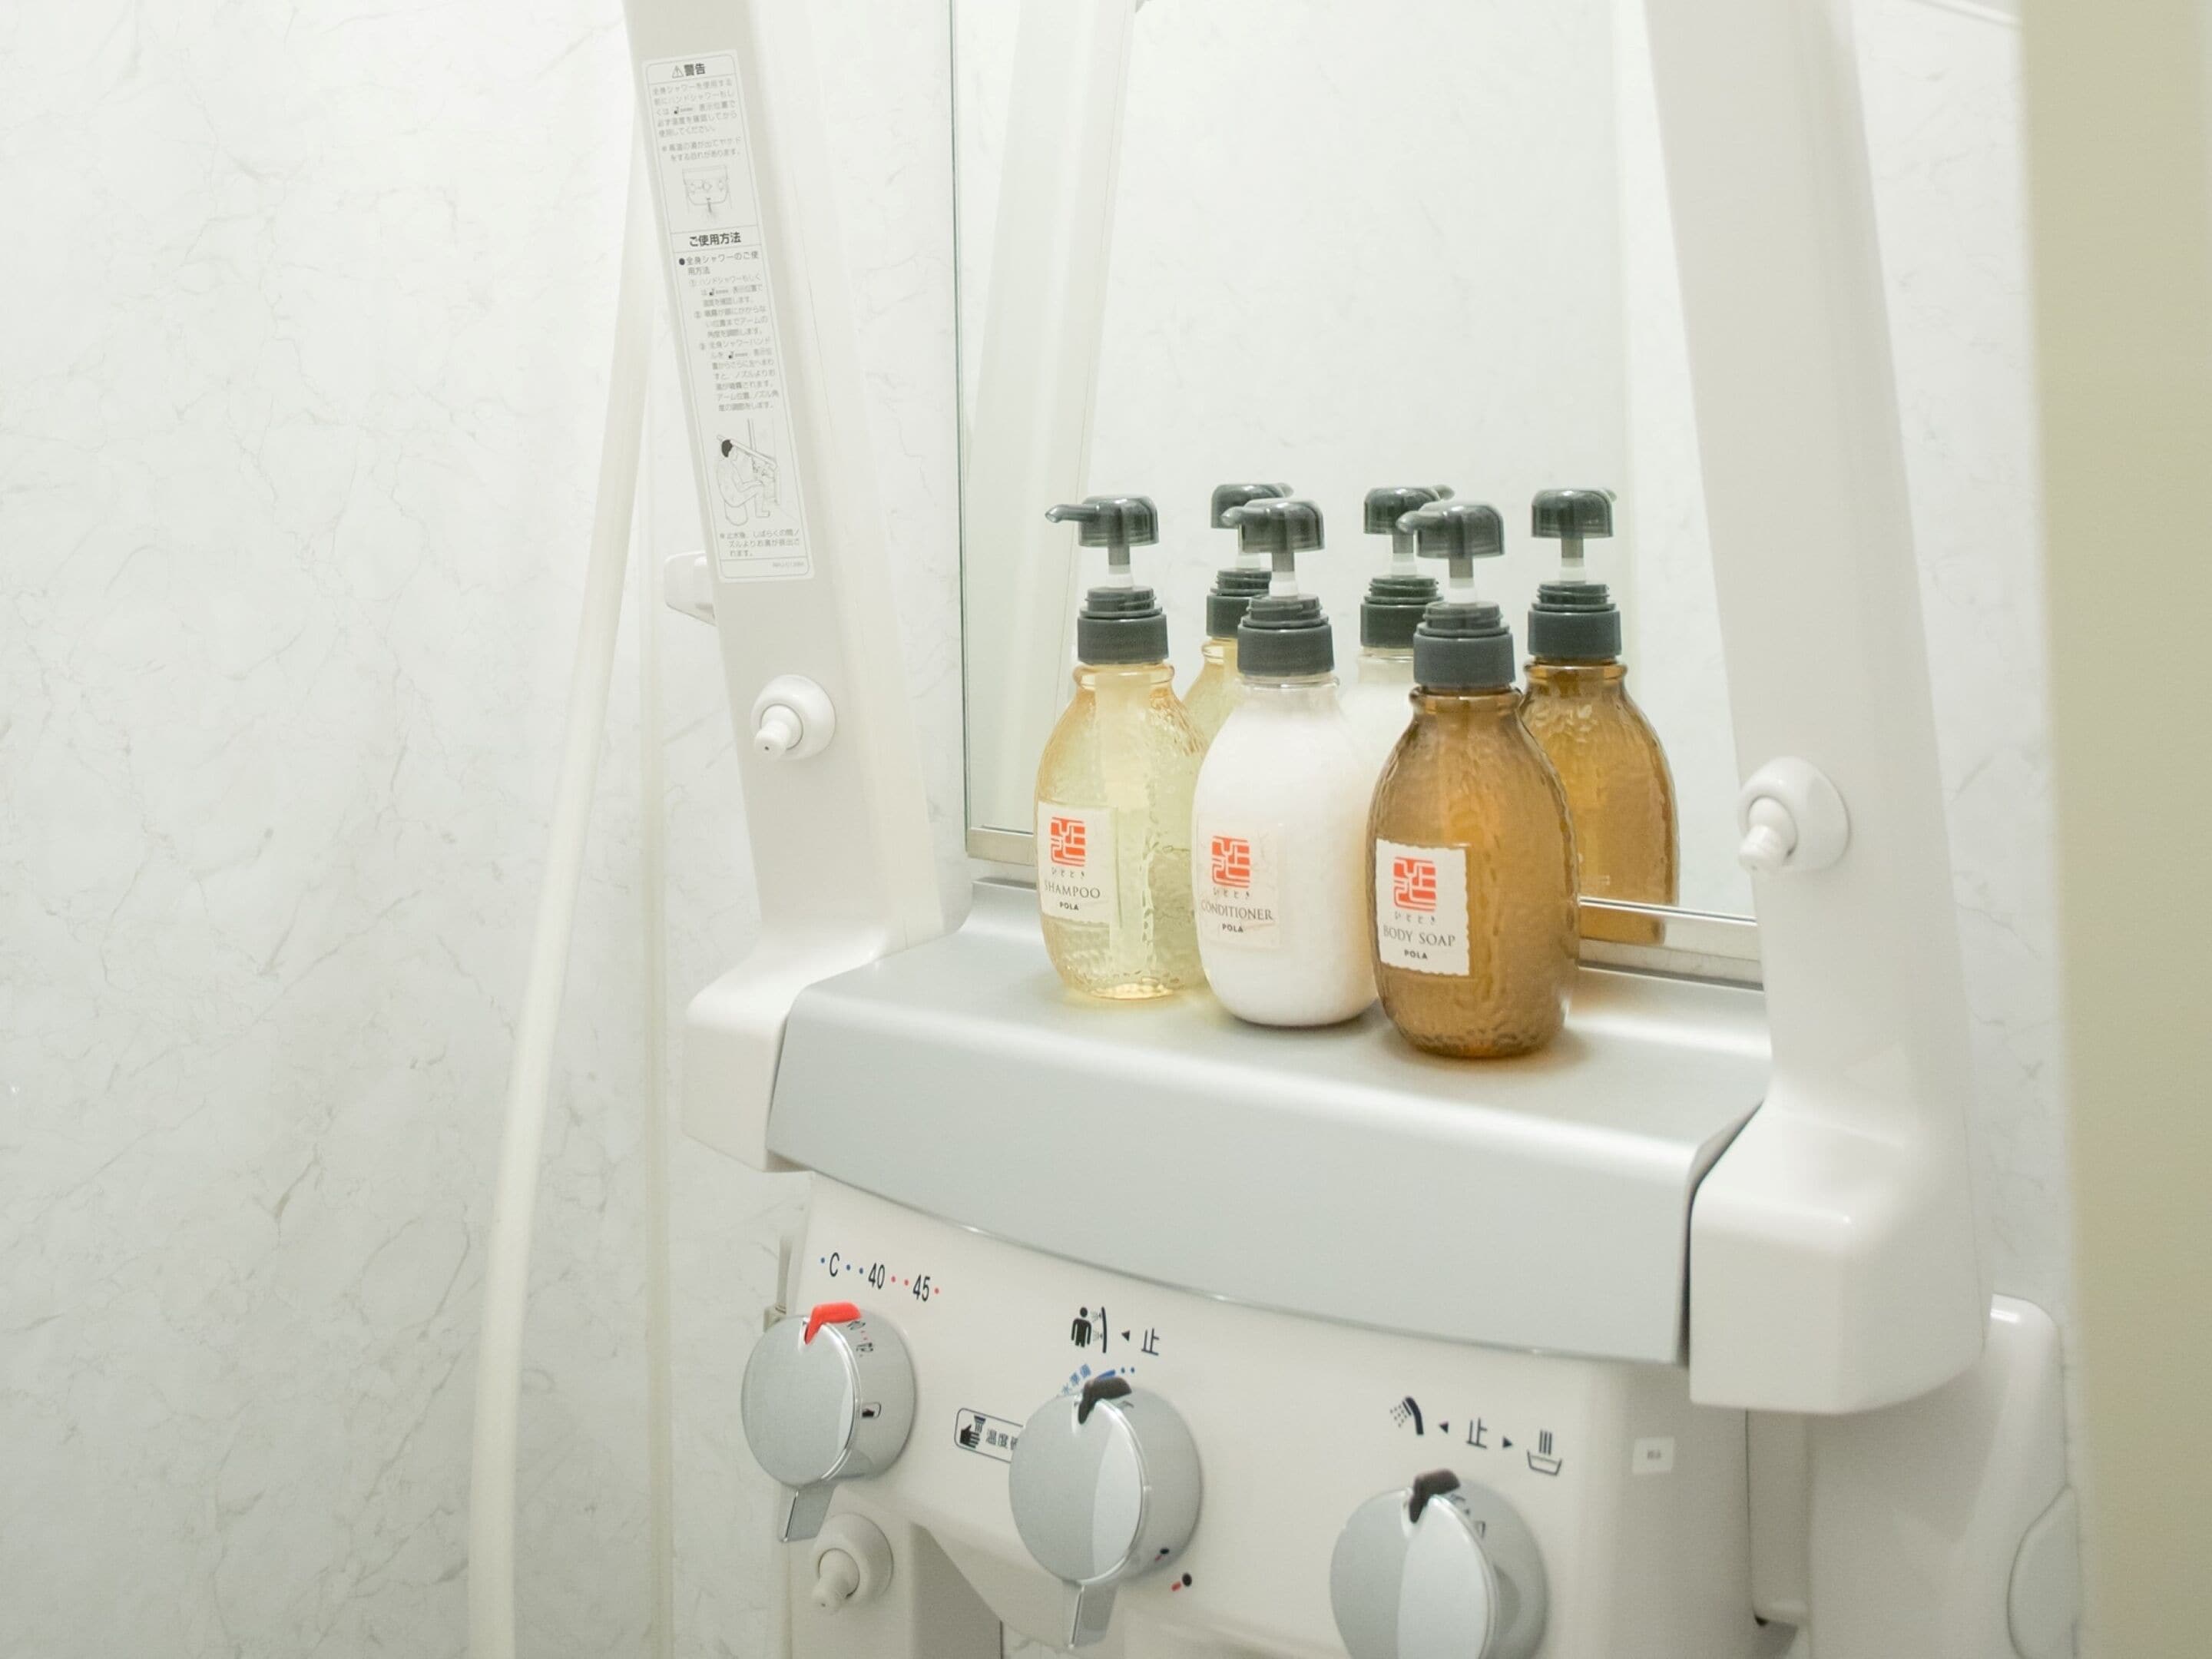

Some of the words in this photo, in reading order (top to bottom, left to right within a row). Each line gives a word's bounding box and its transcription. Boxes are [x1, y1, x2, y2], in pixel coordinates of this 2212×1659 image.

[684, 63, 706, 76] 警告
[689, 232, 742, 247] ご使用方法
[1045, 879, 1101, 899] SHAMPOO
[1059, 901, 1079, 911] POLA
[1200, 899, 1275, 920] CONDITIONER
[1222, 922, 1243, 932] POLA
[1382, 924, 1413, 943] BODY
[1419, 931, 1456, 947] SOAP
[1404, 949, 1428, 959] POLA
[829, 1252, 840, 1277] C
[867, 1262, 886, 1290] 40
[912, 1273, 931, 1302] 45
[1141, 1328, 1160, 1356] 止
[1465, 1418, 1488, 1449] 止
